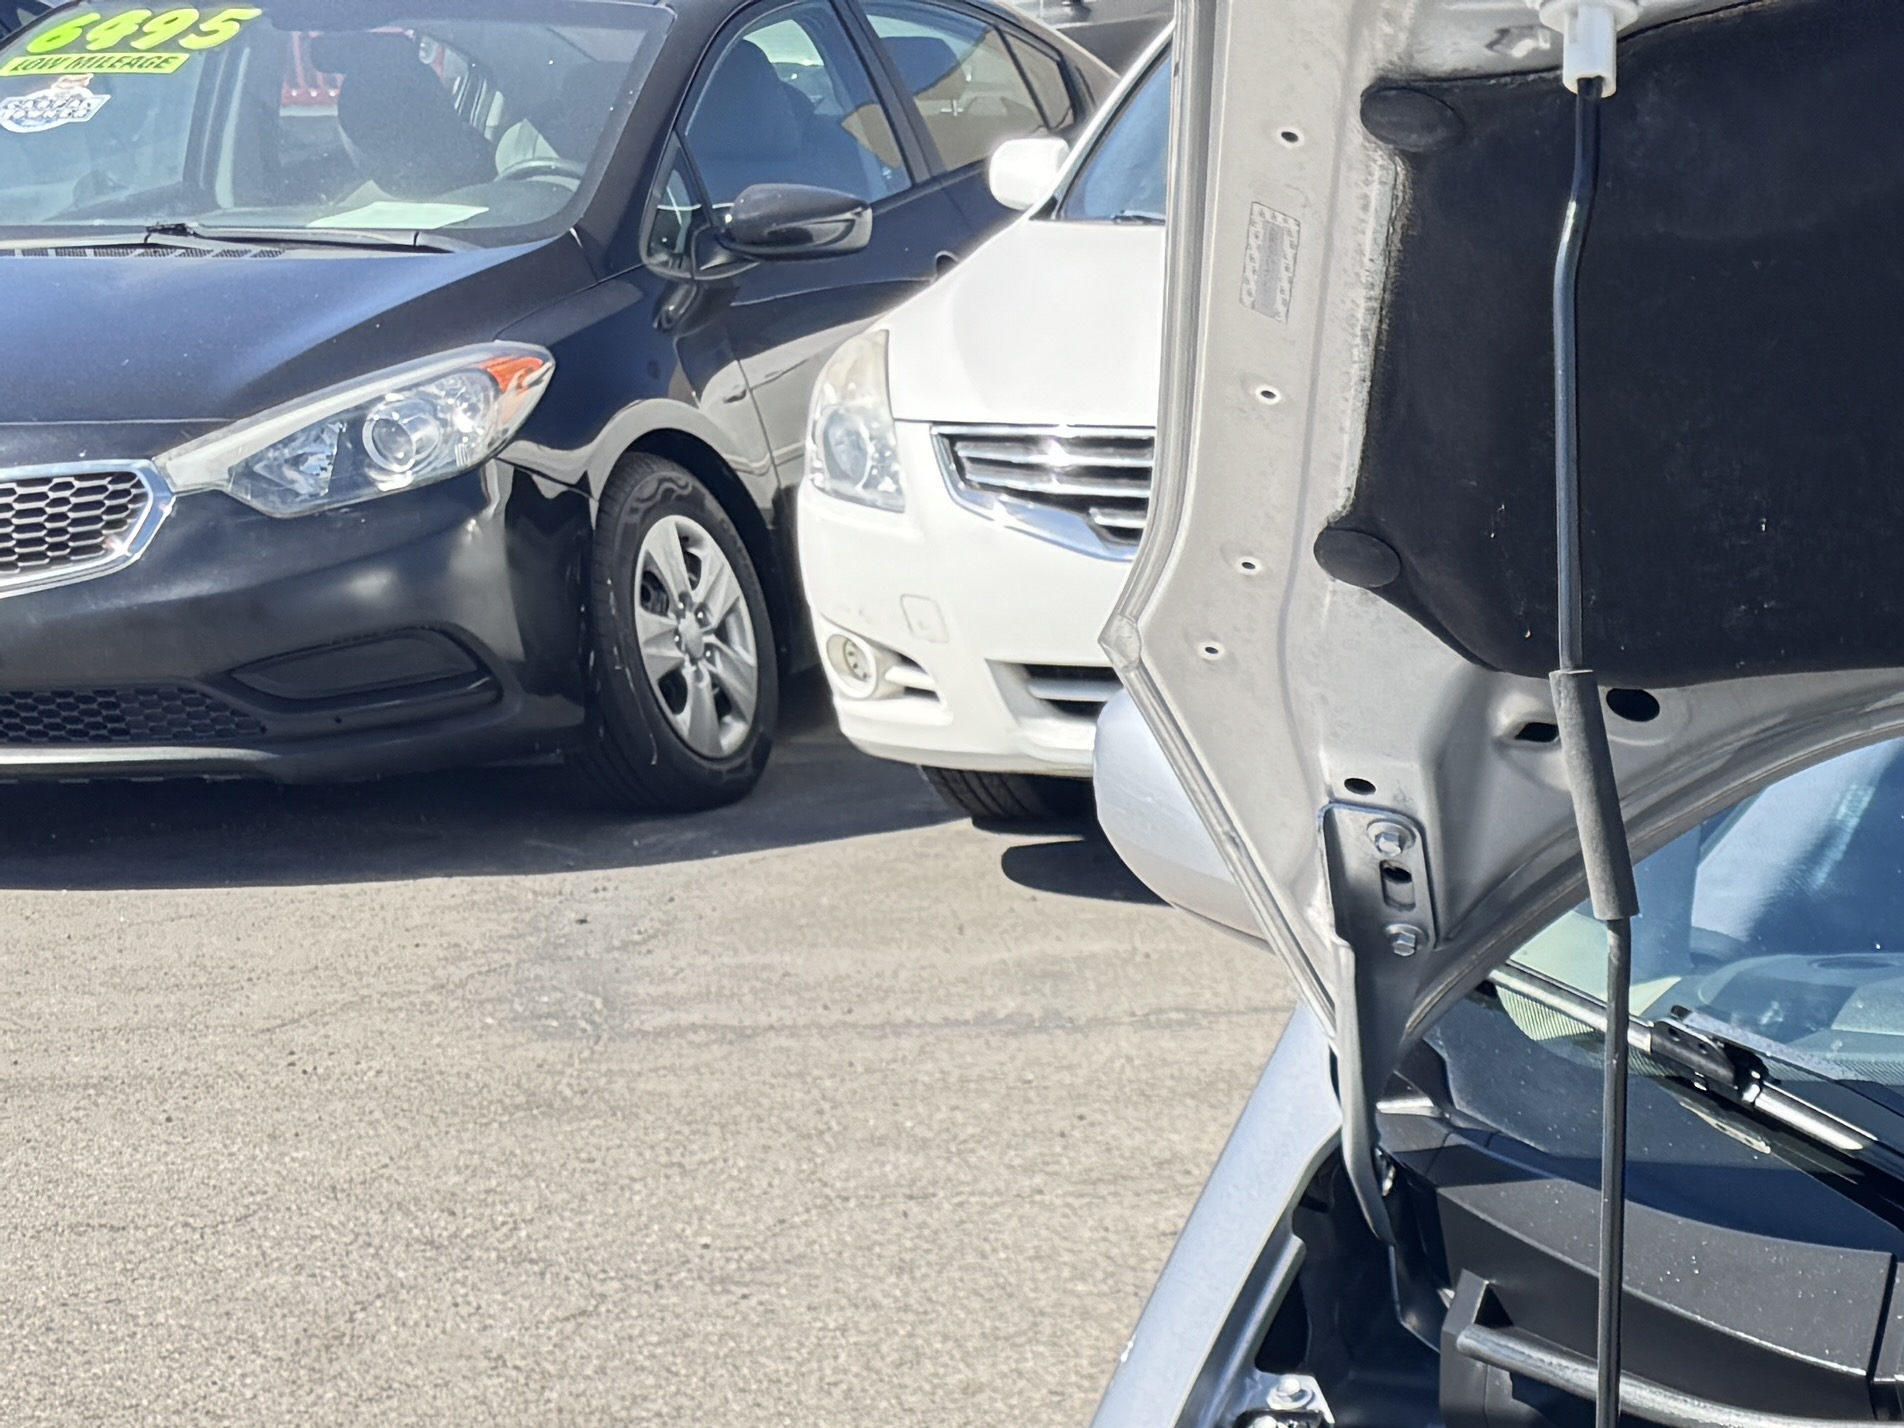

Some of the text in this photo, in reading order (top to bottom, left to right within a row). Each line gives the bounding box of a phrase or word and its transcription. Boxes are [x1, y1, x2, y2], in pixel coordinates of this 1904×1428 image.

[26, 8, 263, 54] 6495
[10, 55, 181, 72] LOW MILEAGE
